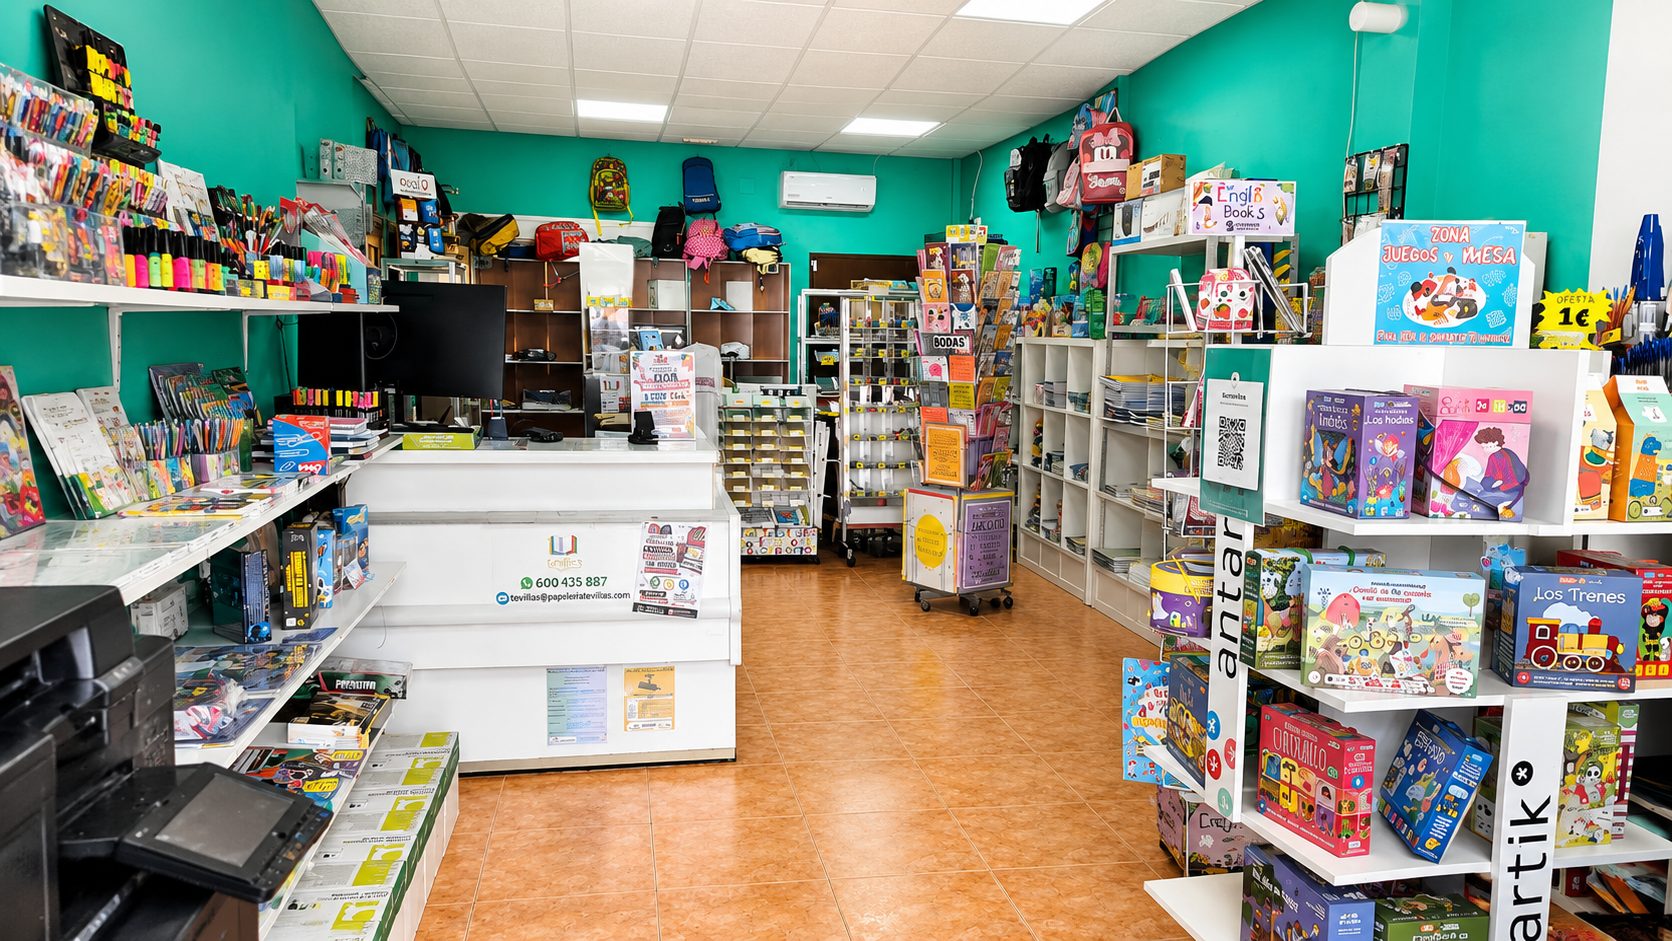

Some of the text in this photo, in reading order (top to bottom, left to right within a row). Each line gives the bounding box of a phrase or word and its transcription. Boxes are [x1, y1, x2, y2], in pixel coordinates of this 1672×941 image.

[1430, 225, 1471, 243] ZONA
[1382, 245, 1439, 264] JUEGOS
[1461, 245, 1517, 265] MESA
[1558, 307, 1589, 327] 1€
[933, 336, 965, 347] BODAS
[536, 576, 608, 588] 600 435 887
[1533, 587, 1626, 604] Los Trenes
[1507, 795, 1551, 941] artik
